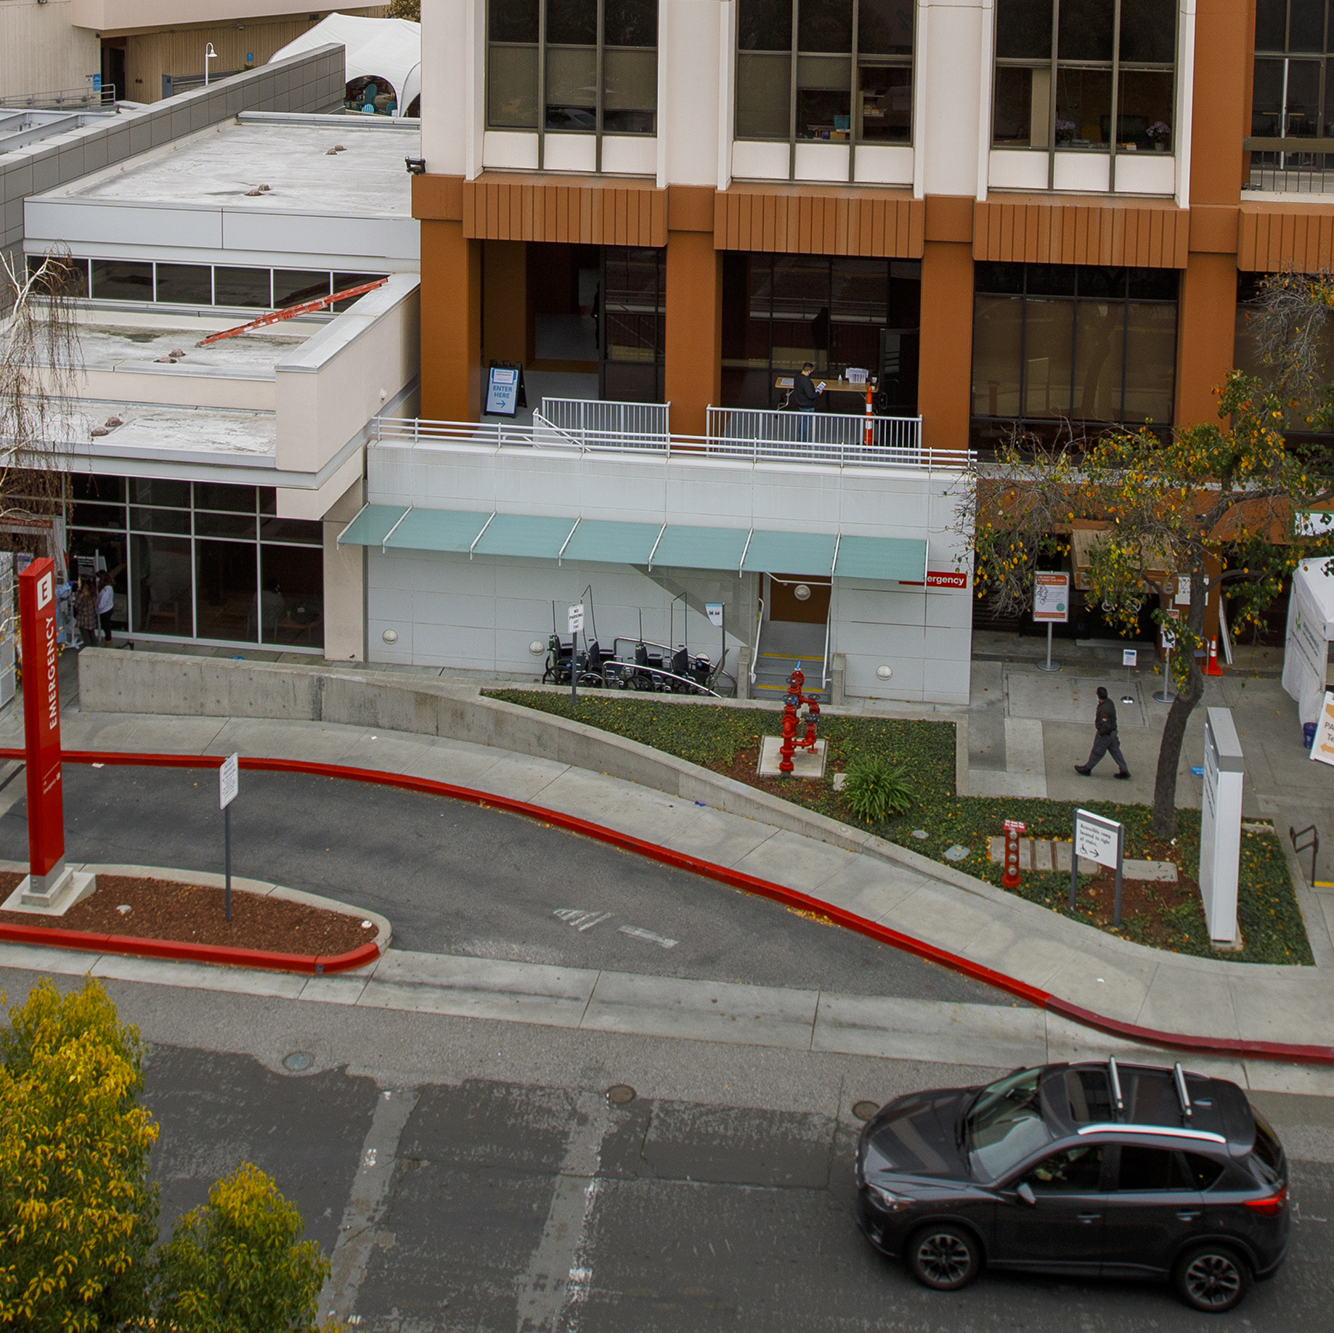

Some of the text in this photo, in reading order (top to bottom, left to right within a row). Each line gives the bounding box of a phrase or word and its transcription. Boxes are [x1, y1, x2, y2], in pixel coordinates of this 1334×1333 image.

[493, 385, 513, 393] ENTER
[927, 575, 965, 586] ergency
[46, 617, 58, 730] EMERGENCY
